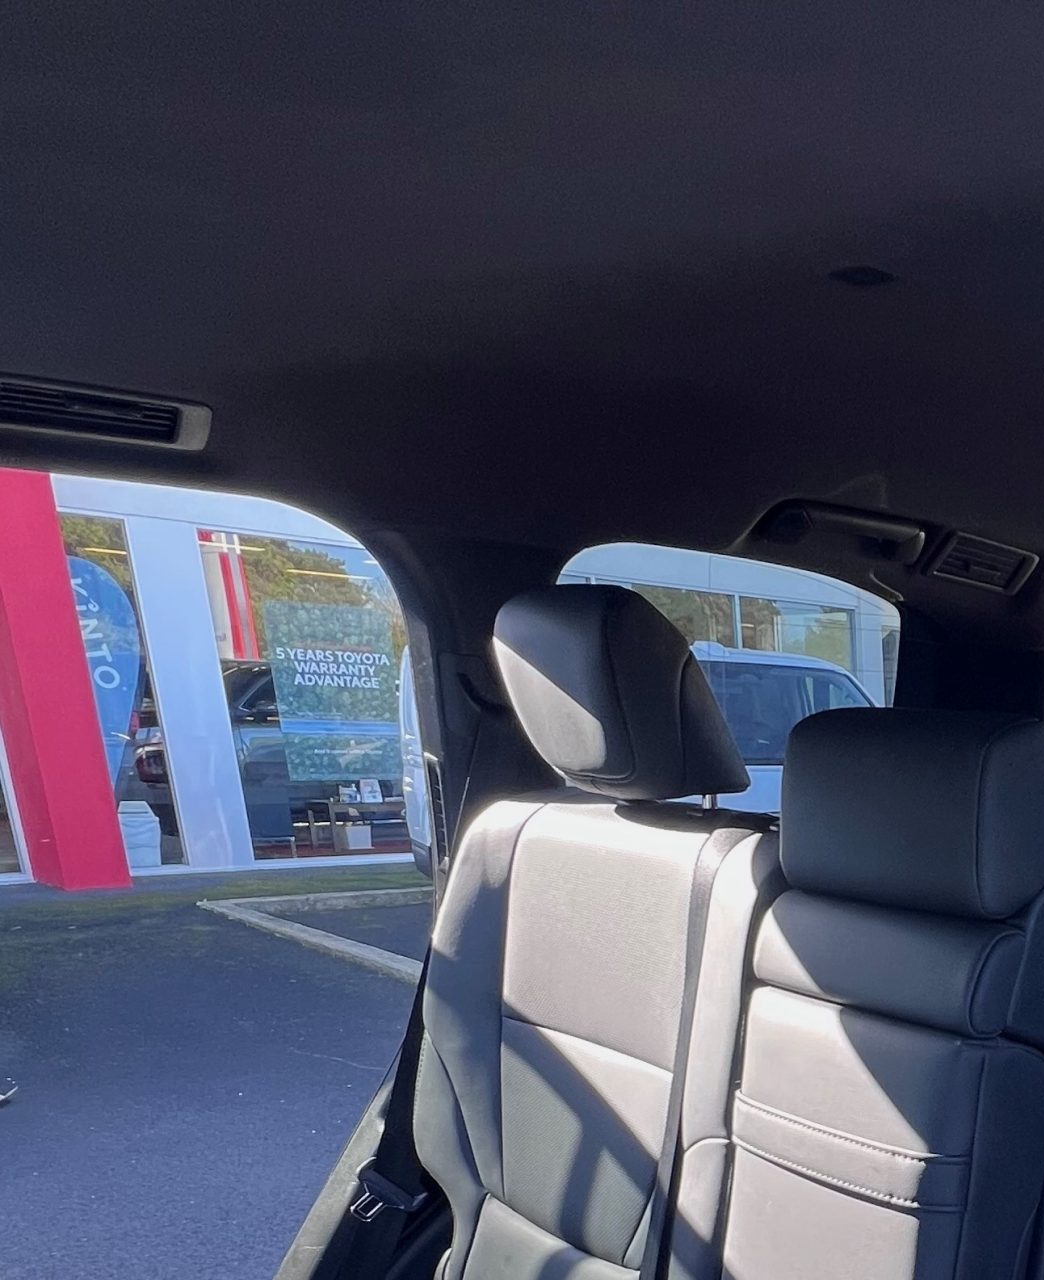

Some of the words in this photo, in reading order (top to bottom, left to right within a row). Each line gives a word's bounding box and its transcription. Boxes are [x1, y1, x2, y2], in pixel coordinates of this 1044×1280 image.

[276, 647, 285, 659] 5
[287, 648, 334, 661] YEARS
[335, 651, 391, 666] TOYOTA
[294, 661, 375, 676] WARRANTY
[294, 673, 380, 688] ADVANTAGE
